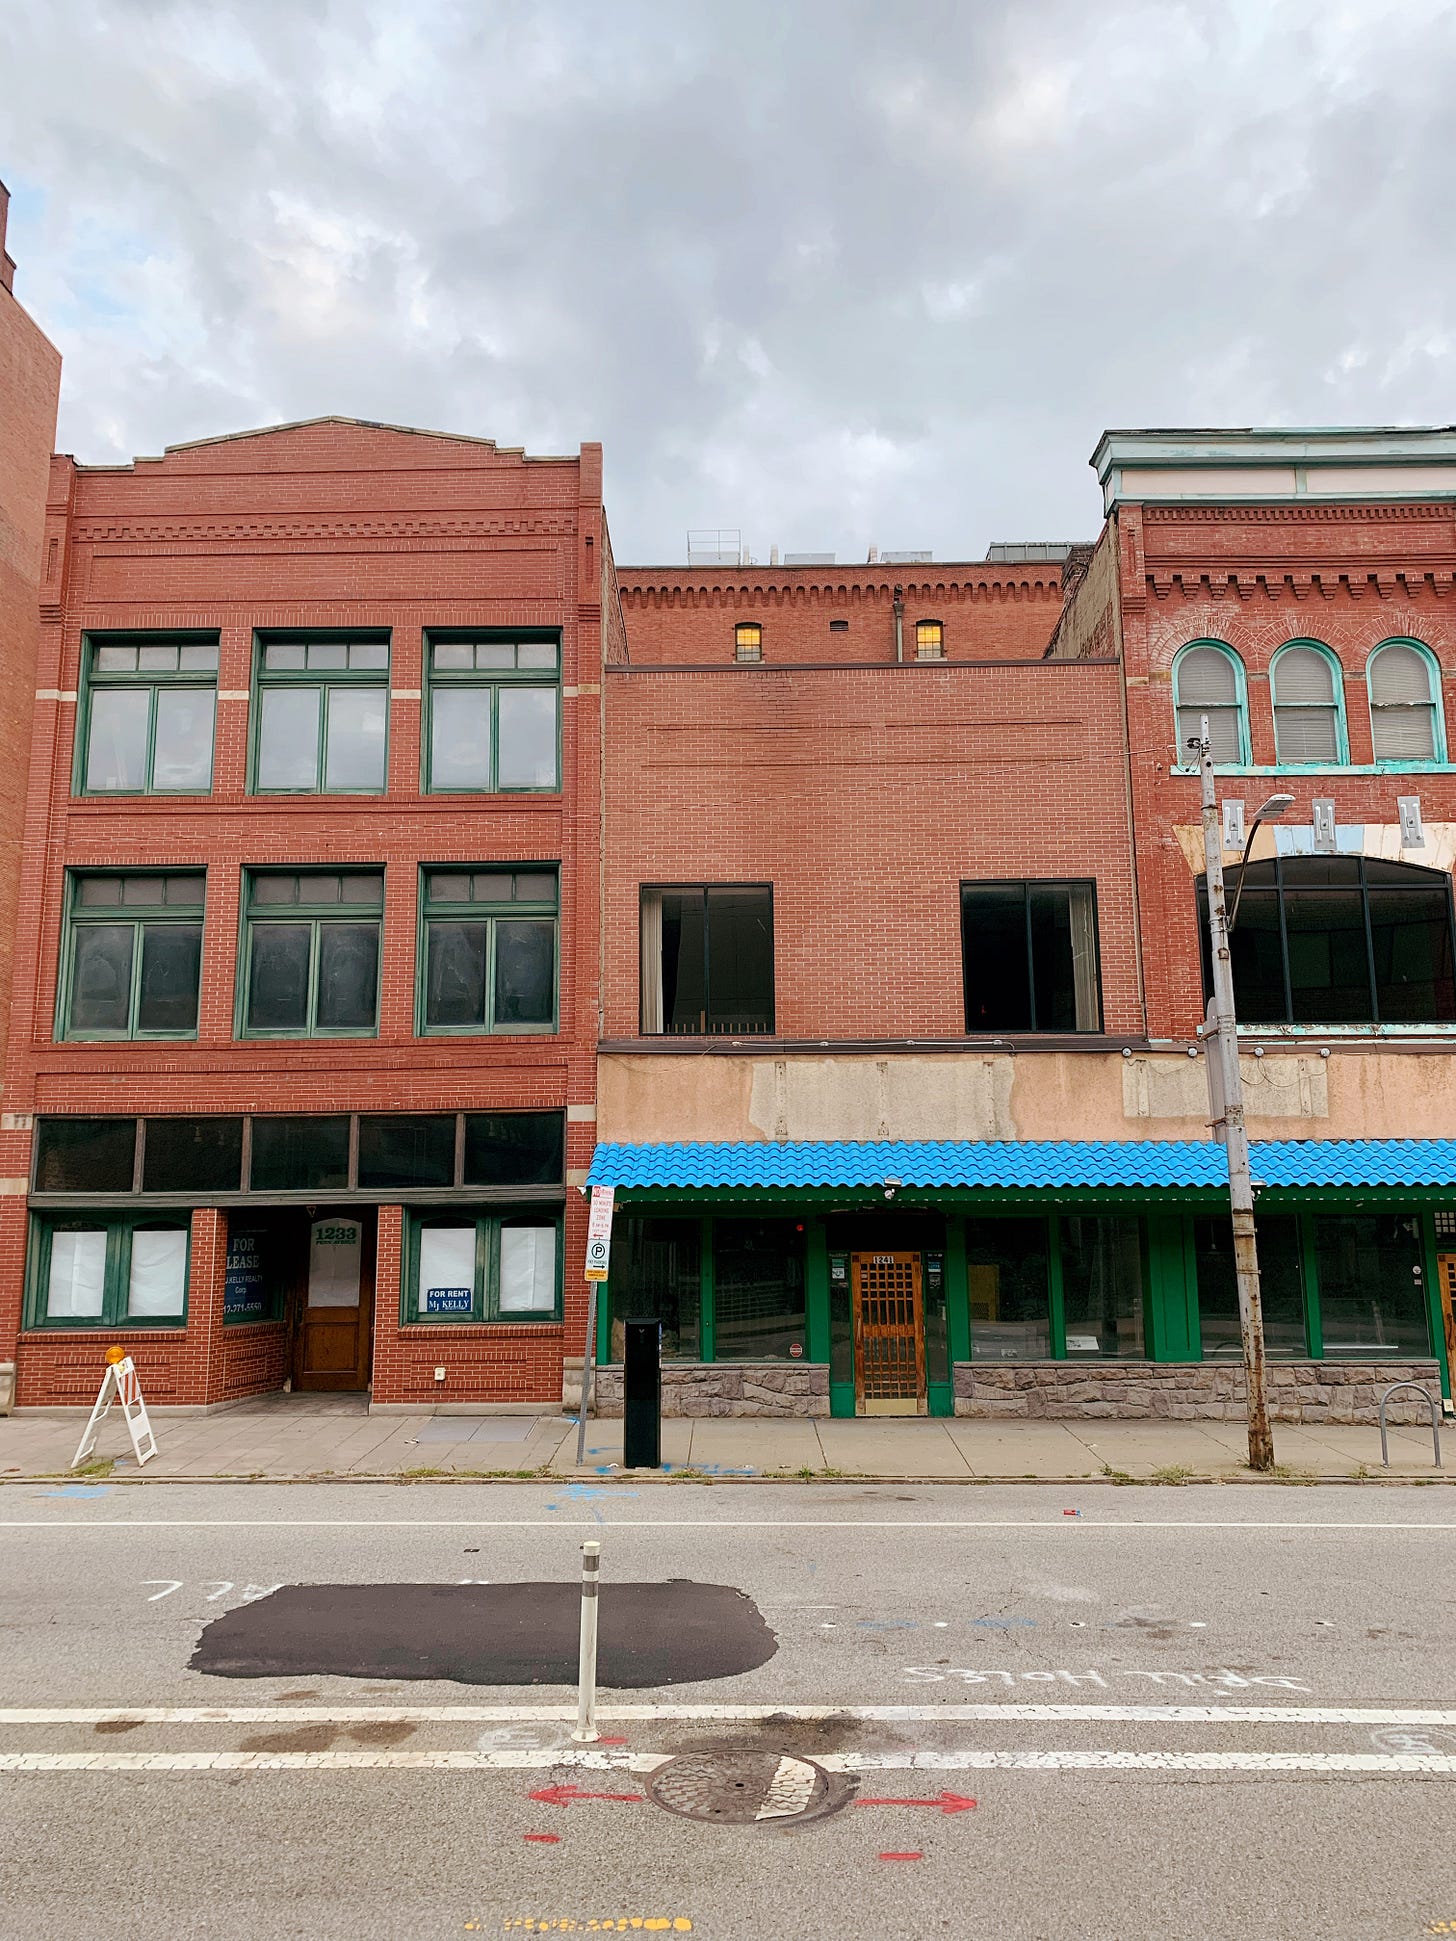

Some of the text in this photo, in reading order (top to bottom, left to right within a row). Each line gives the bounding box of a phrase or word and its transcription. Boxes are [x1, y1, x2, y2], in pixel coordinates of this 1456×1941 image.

[315, 1227, 357, 1240] 1233
[232, 1238, 255, 1252] FOR
[226, 1255, 260, 1270] LEASE
[873, 1256, 894, 1264] 1241
[429, 1290, 469, 1298] FOR RENT
[442, 1300, 469, 1308] KELLY
